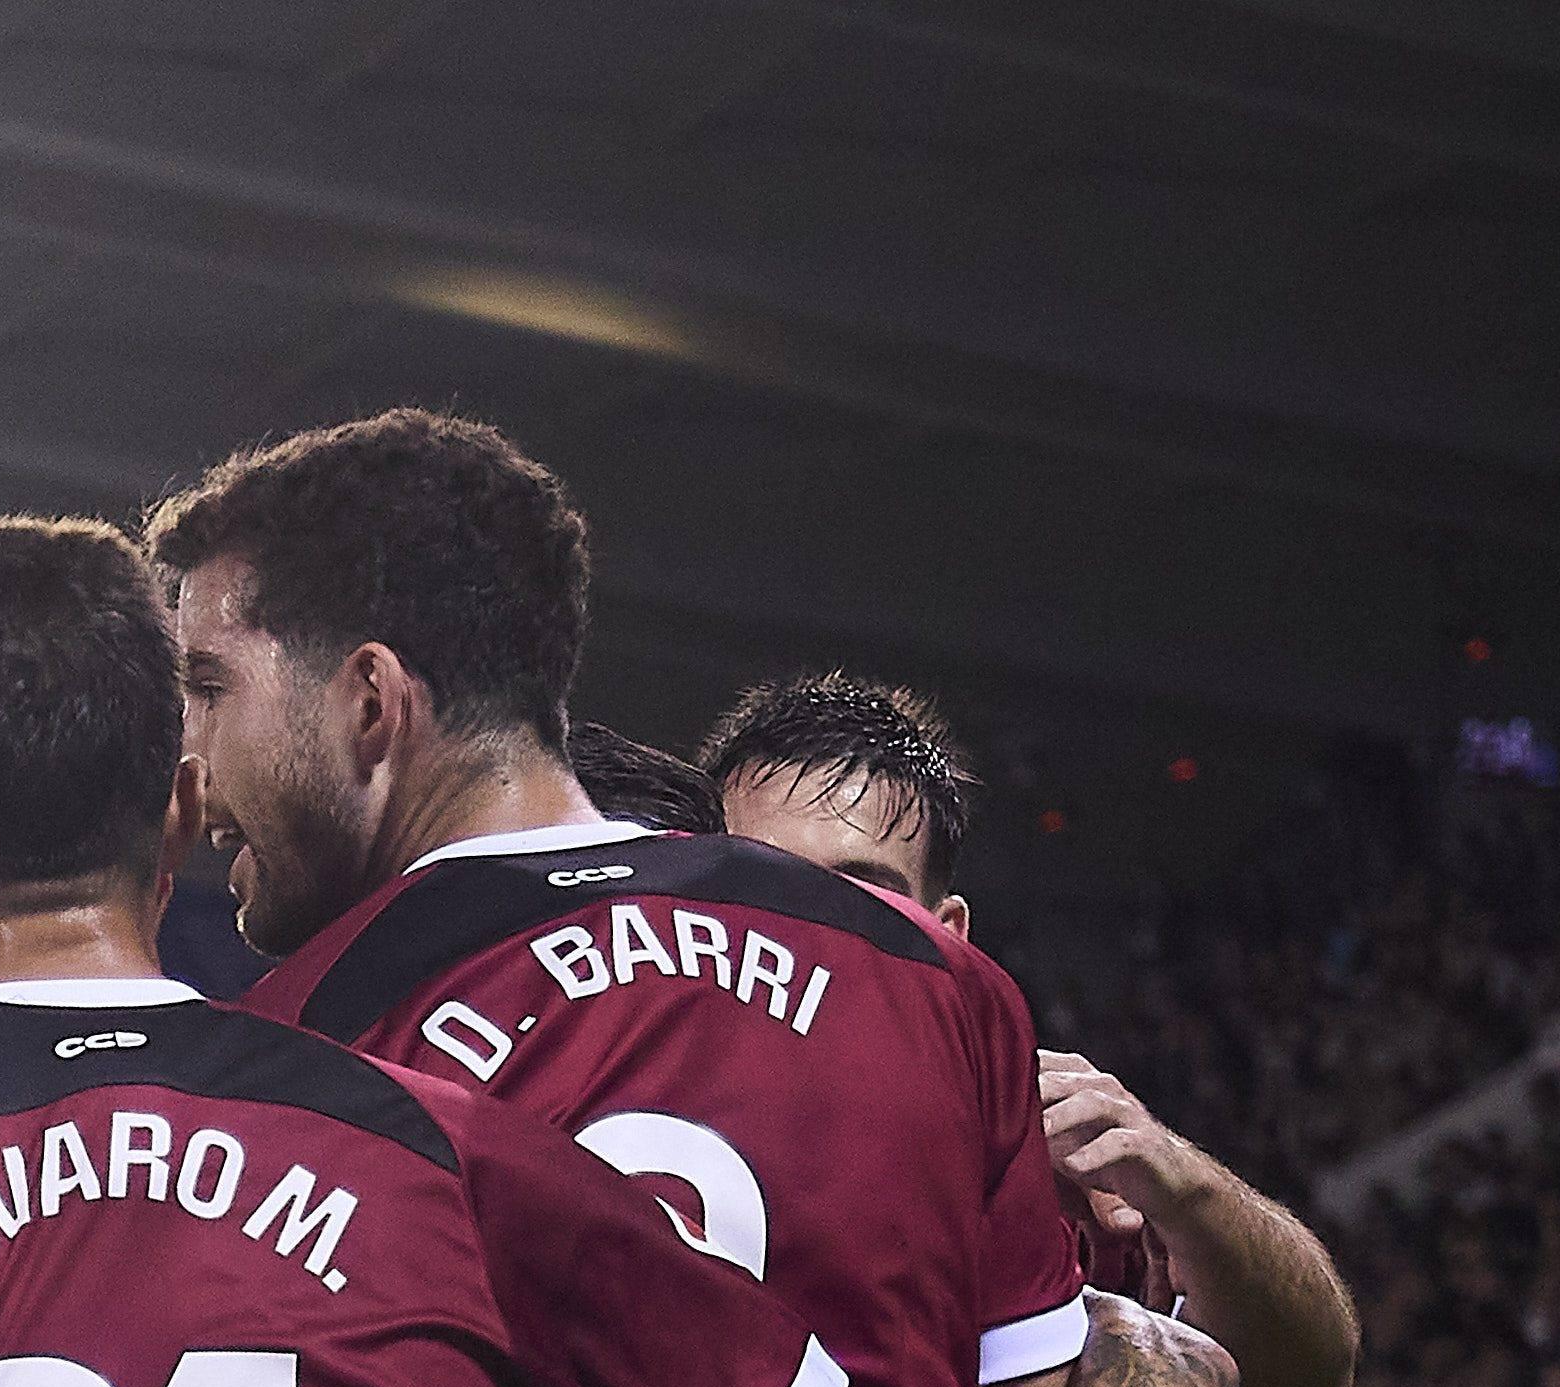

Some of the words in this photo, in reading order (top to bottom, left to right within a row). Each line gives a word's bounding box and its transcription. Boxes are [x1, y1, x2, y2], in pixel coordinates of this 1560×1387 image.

[421, 1001, 536, 1082] D.
[530, 904, 831, 1036] BARRI
[243, 1164, 358, 1293] M.
